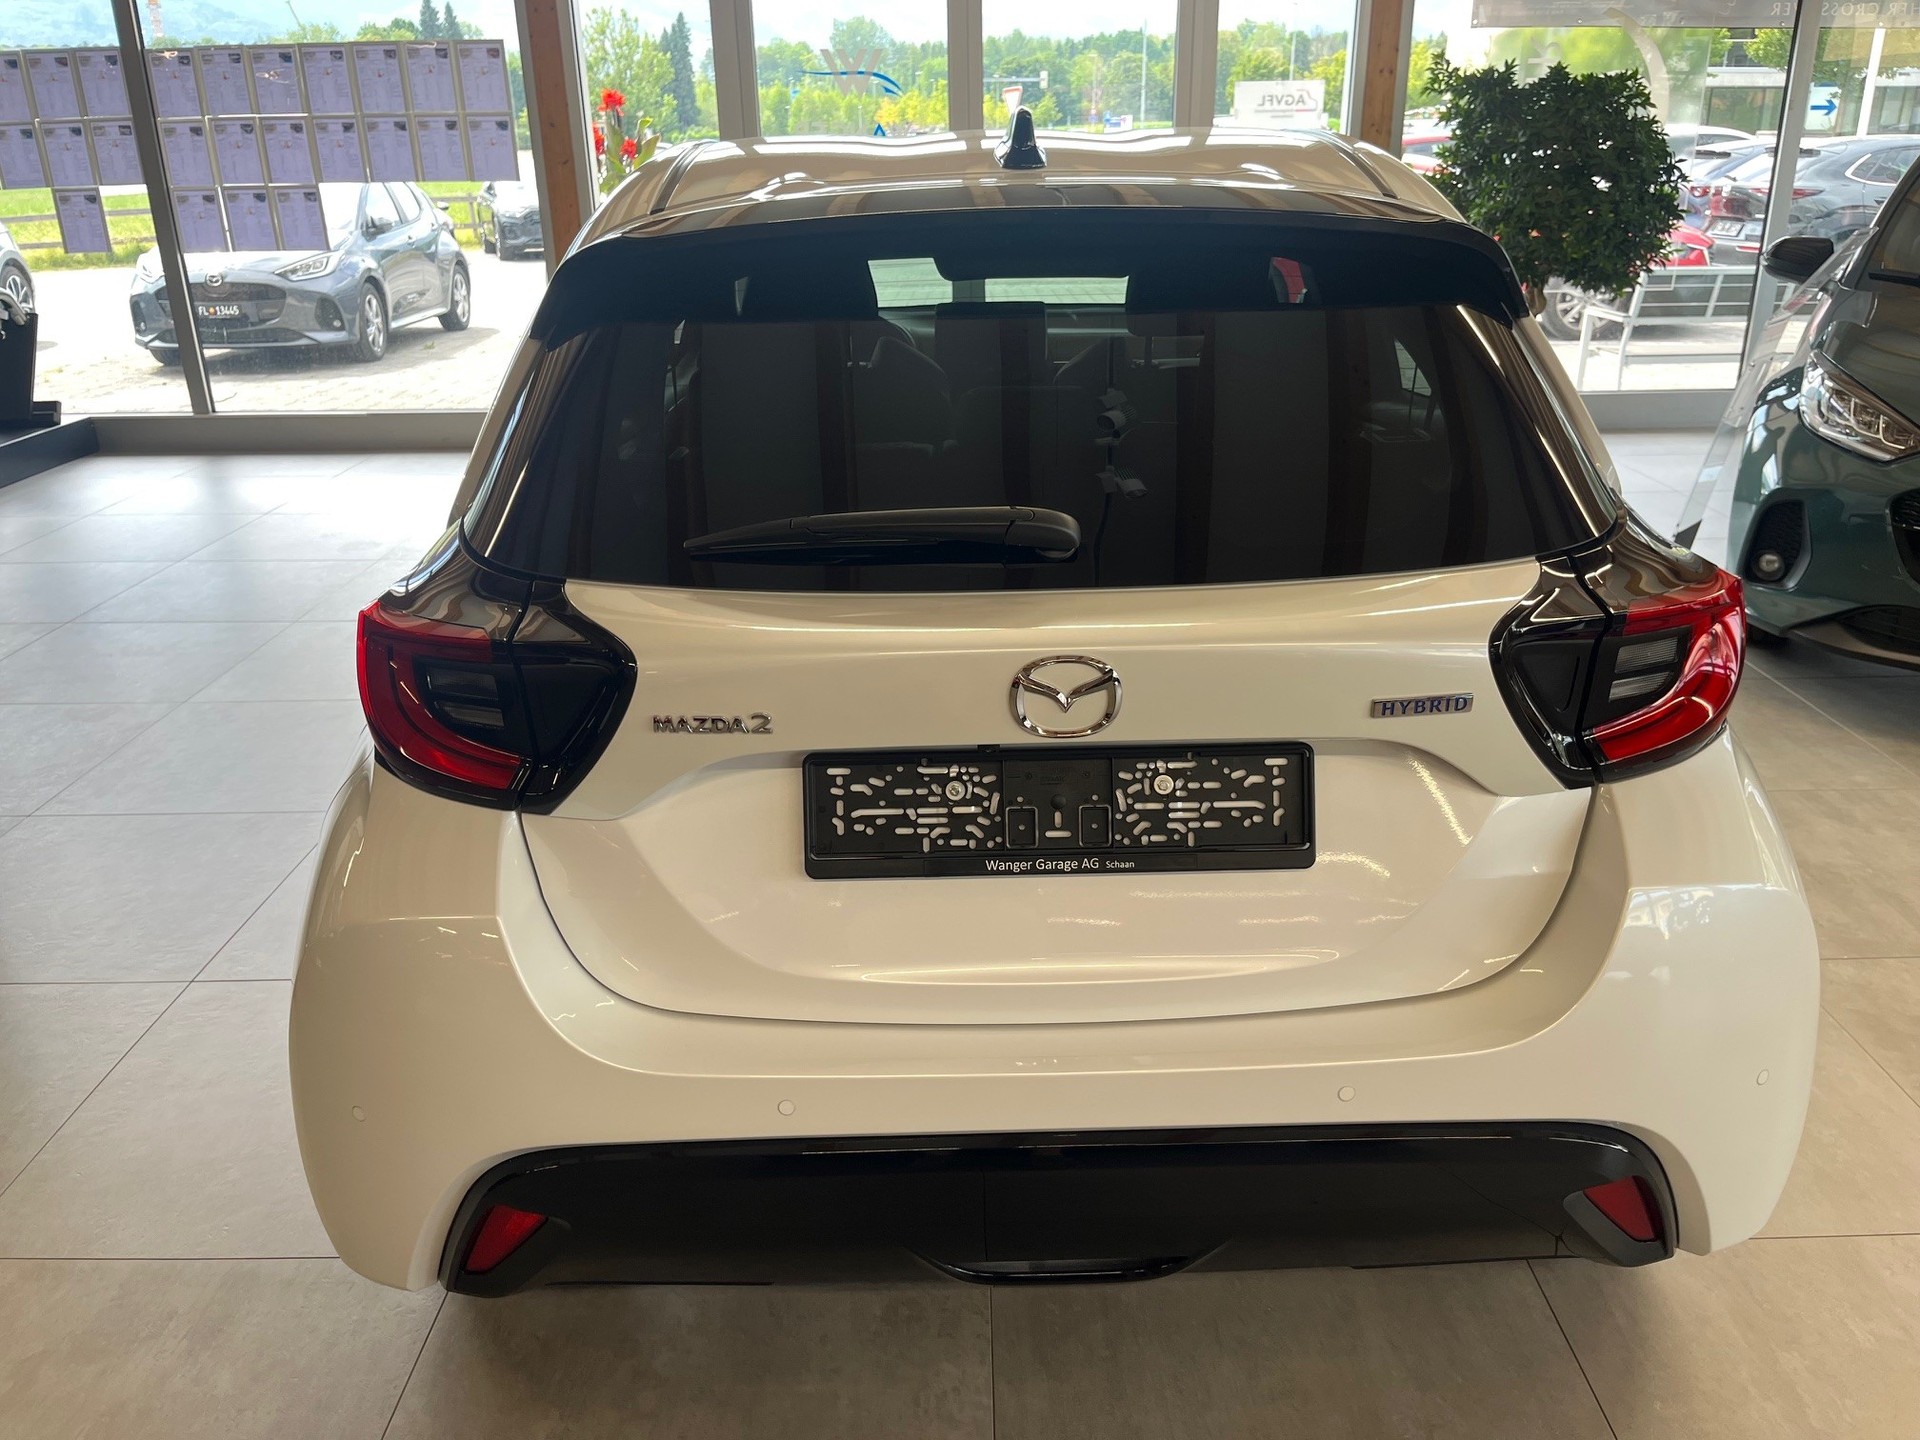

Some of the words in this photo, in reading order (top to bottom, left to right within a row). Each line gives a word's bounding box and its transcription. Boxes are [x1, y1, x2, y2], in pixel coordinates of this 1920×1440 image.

[198, 305, 209, 316] FL
[1381, 696, 1468, 716] HYBRID
[985, 859, 1032, 873] Wanger
[1035, 858, 1079, 872] Garage
[1081, 857, 1099, 869] AG
[1105, 860, 1135, 869] Schaan
